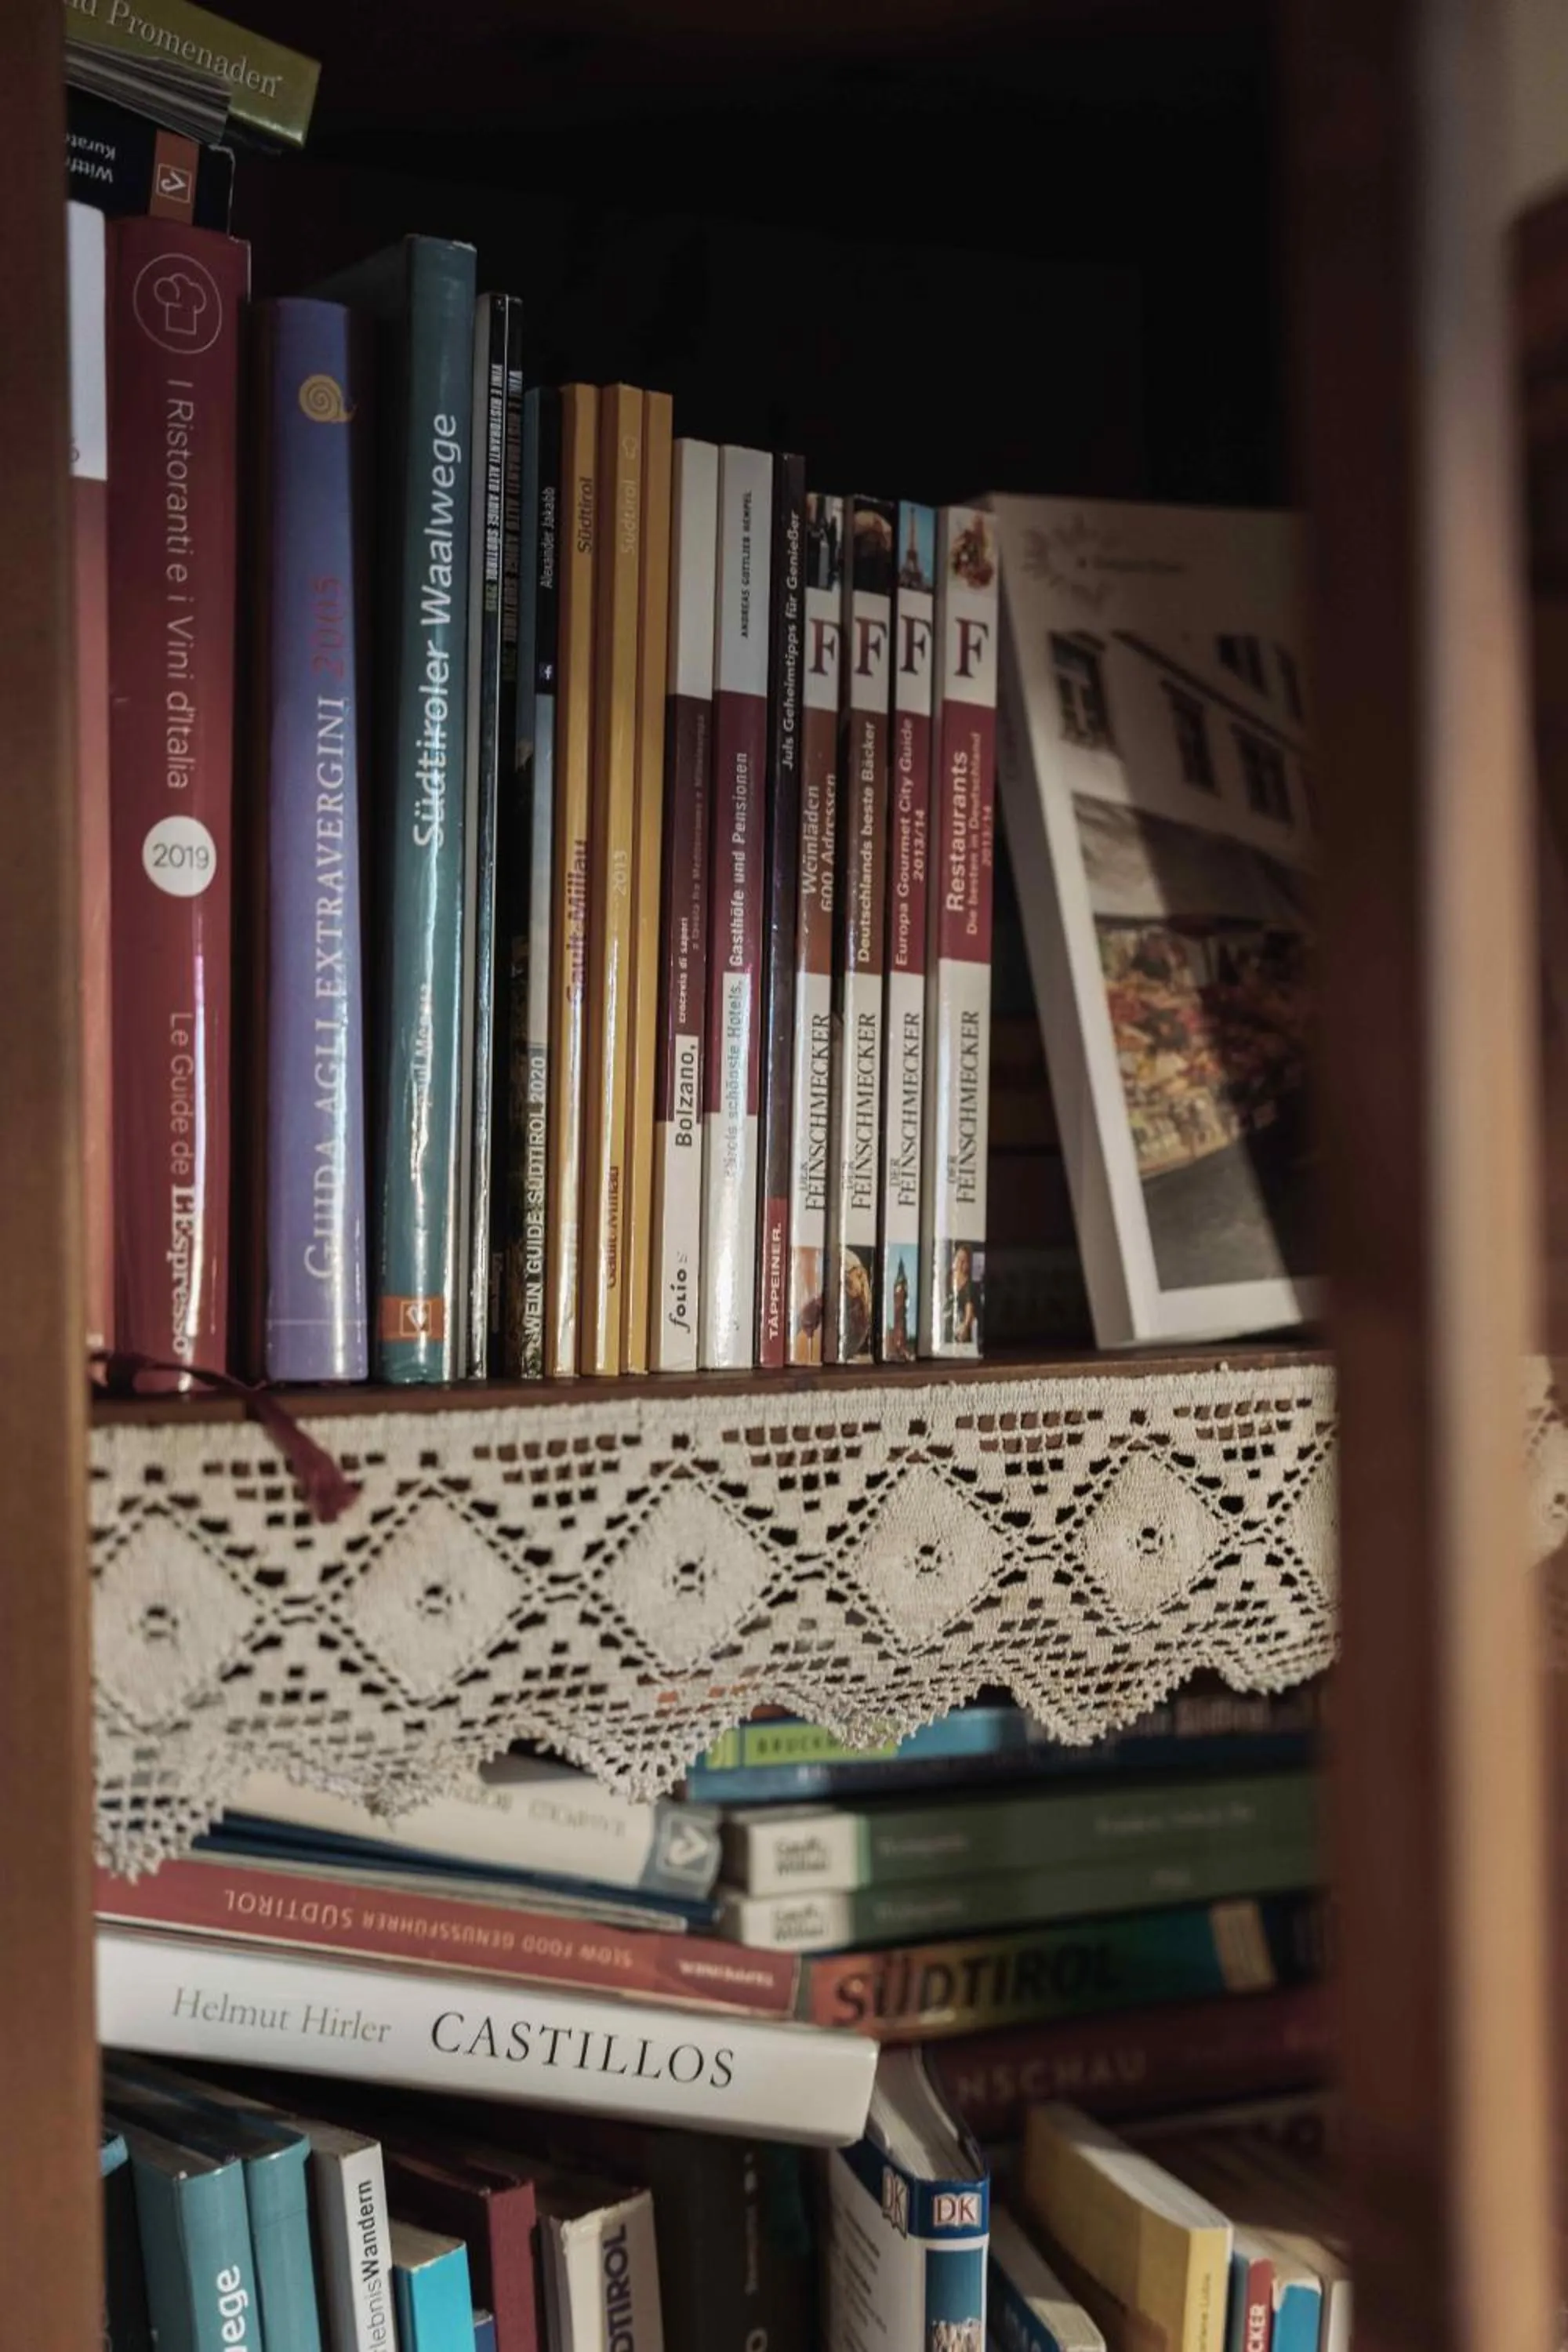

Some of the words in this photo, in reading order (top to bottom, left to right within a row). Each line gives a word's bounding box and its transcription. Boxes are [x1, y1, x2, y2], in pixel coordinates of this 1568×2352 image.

[107, 0, 278, 98] Promenaden
[165, 397, 195, 554] Ristoranti
[419, 413, 462, 626] Waalwege
[576, 476, 593, 554] Südtirol
[619, 479, 638, 555] Südtirol
[741, 491, 753, 532] HEMPEL
[165, 563, 187, 583] e
[784, 510, 801, 590] Genießer
[165, 594, 194, 603] i
[309, 572, 345, 681] 2005
[782, 595, 799, 619] für
[165, 615, 195, 680] Vini
[808, 618, 841, 677] F
[854, 617, 887, 677] F
[899, 614, 932, 674] F
[953, 618, 989, 678] F
[782, 624, 800, 732] Geheimtipps
[165, 690, 196, 789] d'Italia
[412, 640, 450, 847] Südtiroler
[782, 736, 797, 770] Juls
[860, 721, 877, 782] Bäcker
[898, 719, 914, 772] Guide
[731, 751, 750, 844] Pensionen
[859, 787, 875, 836] beste
[898, 776, 916, 812] City
[967, 732, 983, 830] Deutschland
[314, 695, 346, 997] EXTRAVERGINI
[801, 785, 820, 895] Weinläden
[820, 773, 837, 866] Adressen
[913, 809, 927, 881] 2013/14
[946, 751, 969, 911] Restaurants
[968, 833, 982, 848] in
[153, 844, 209, 870] 2019
[730, 851, 747, 884] und
[897, 815, 913, 897] Gourmet
[967, 852, 981, 906] besten
[820, 872, 835, 913] 600
[858, 840, 874, 963] Deutschlands
[967, 913, 979, 935] Die
[678, 916, 691, 954] sapori
[726, 889, 746, 967] Gasthöfe
[896, 902, 913, 966] Europa
[170, 1011, 194, 1046] Le
[726, 980, 742, 1039] Hotels.
[169, 1054, 194, 1134] Guide
[313, 1018, 343, 1114] AGLI
[529, 1056, 546, 1102] 2020
[673, 1044, 696, 1148] Bolzano,
[723, 1044, 741, 1120] schönste
[804, 1013, 831, 1210] FEINSCHMECKER
[850, 1012, 877, 1210] FEINSCHMECKER
[897, 1012, 920, 1207] FEINSCHMECKER
[954, 1011, 979, 1204] FEINSCHMECKER
[169, 1142, 191, 1175] de
[889, 1158, 901, 1187] DER
[303, 1139, 342, 1279] GUIDA
[525, 1211, 543, 1273] GUIDE
[524, 1281, 541, 1334] WEIN
[222, 1887, 354, 1929] SÜDTIROL
[361, 1910, 516, 1949] GENUSSFÜHRER
[521, 1933, 574, 1959] FOOD
[580, 1942, 634, 1969] SLOW
[172, 1986, 291, 2033] Helmut
[299, 2002, 394, 2045] Hirler
[430, 2011, 736, 2089] CASTILLOS
[937, 2196, 975, 2223] DK
[215, 2263, 250, 2352] ege
